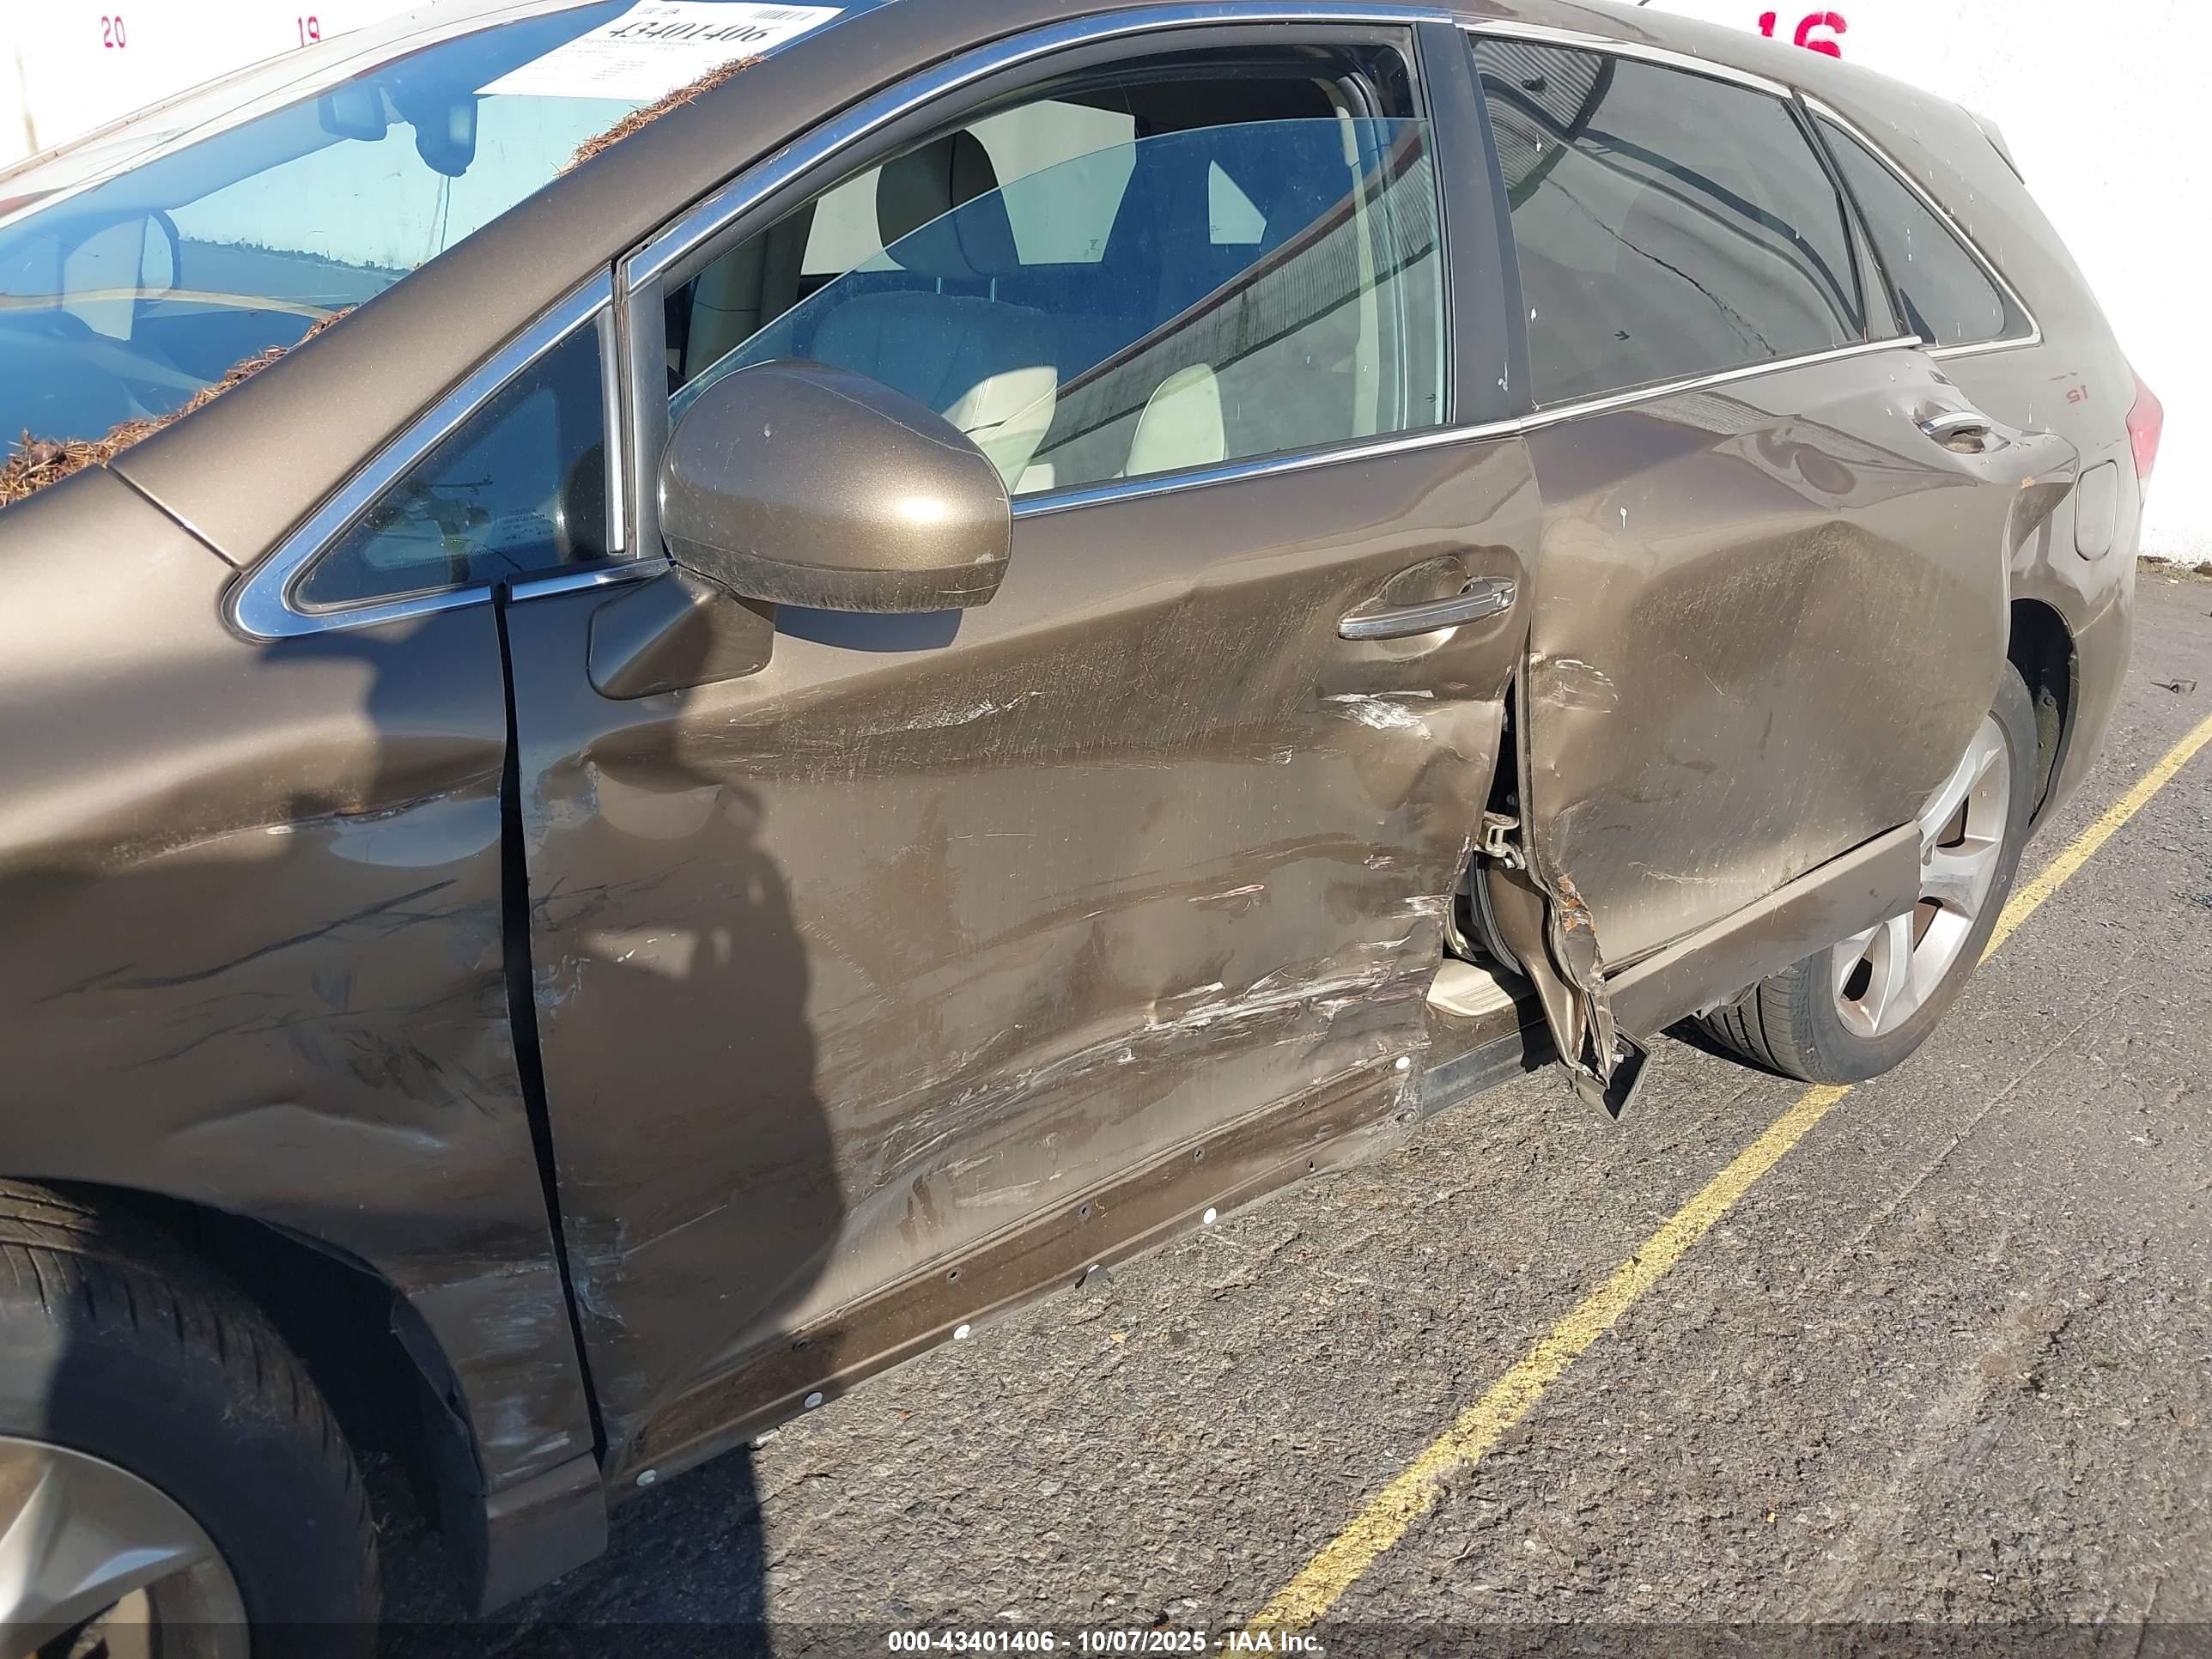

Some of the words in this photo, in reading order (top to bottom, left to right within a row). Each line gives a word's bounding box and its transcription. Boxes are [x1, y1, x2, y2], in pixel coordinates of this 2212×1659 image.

[101, 15, 125, 48] 20
[298, 15, 320, 48] 19
[609, 21, 783, 43] 43401406
